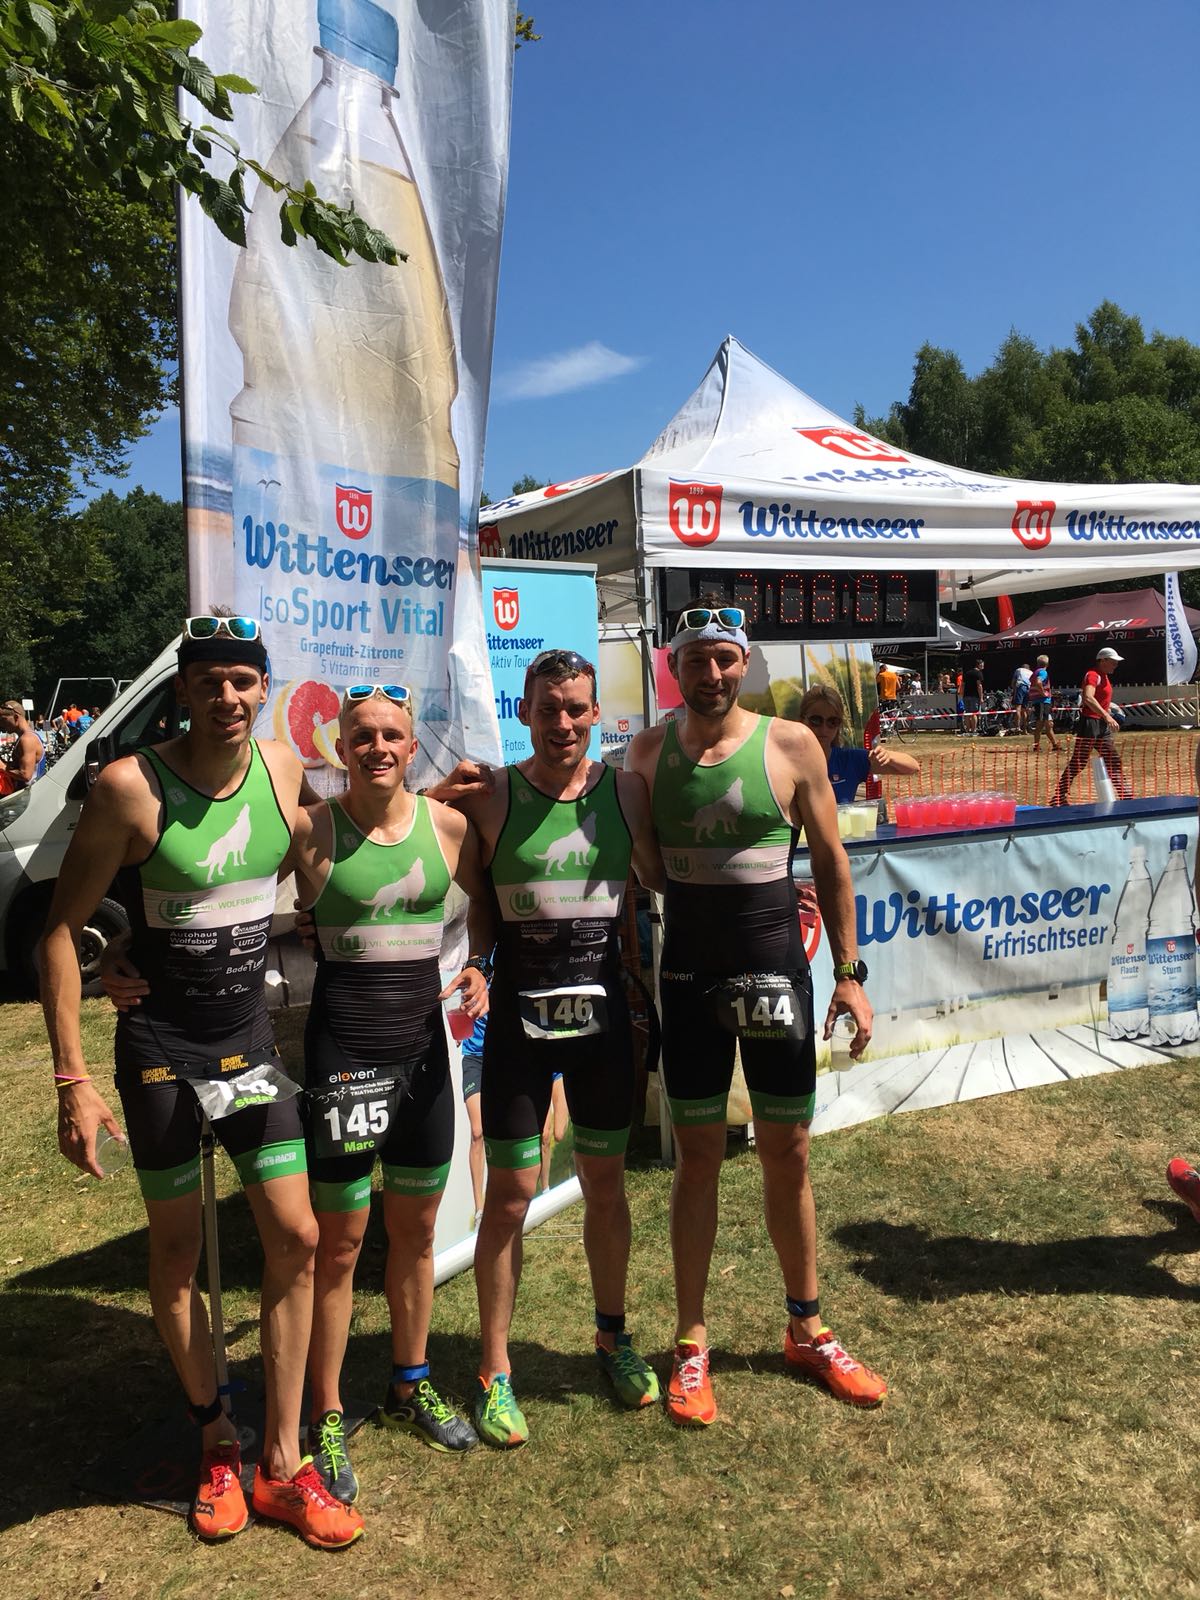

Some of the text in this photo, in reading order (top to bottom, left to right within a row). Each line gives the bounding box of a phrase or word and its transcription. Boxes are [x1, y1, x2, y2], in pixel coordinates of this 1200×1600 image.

[738, 501, 925, 539] Wittenseer
[508, 519, 619, 560] Wittenseer
[380, 598, 445, 637] Vital
[300, 637, 404, 660] Grapefruit-Zitrone
[485, 633, 545, 650] ittenseer
[320, 659, 380, 678] 5 Vitamine
[491, 656, 512, 669] Aktiv
[217, 894, 265, 910] WOLFSBURG
[855, 882, 1110, 946] Wittenseer
[170, 937, 218, 945] Wolfsburg
[238, 938, 255, 947] LUTZ
[982, 924, 1109, 962] Erfrischtseer
[1162, 966, 1182, 975] Sturm
[533, 993, 594, 1027] 146
[730, 994, 795, 1027] 144
[742, 1028, 787, 1039] Hendrik
[350, 1087, 384, 1097] TRIATHLON
[324, 1099, 389, 1142] 145
[344, 1139, 375, 1153] Marc
